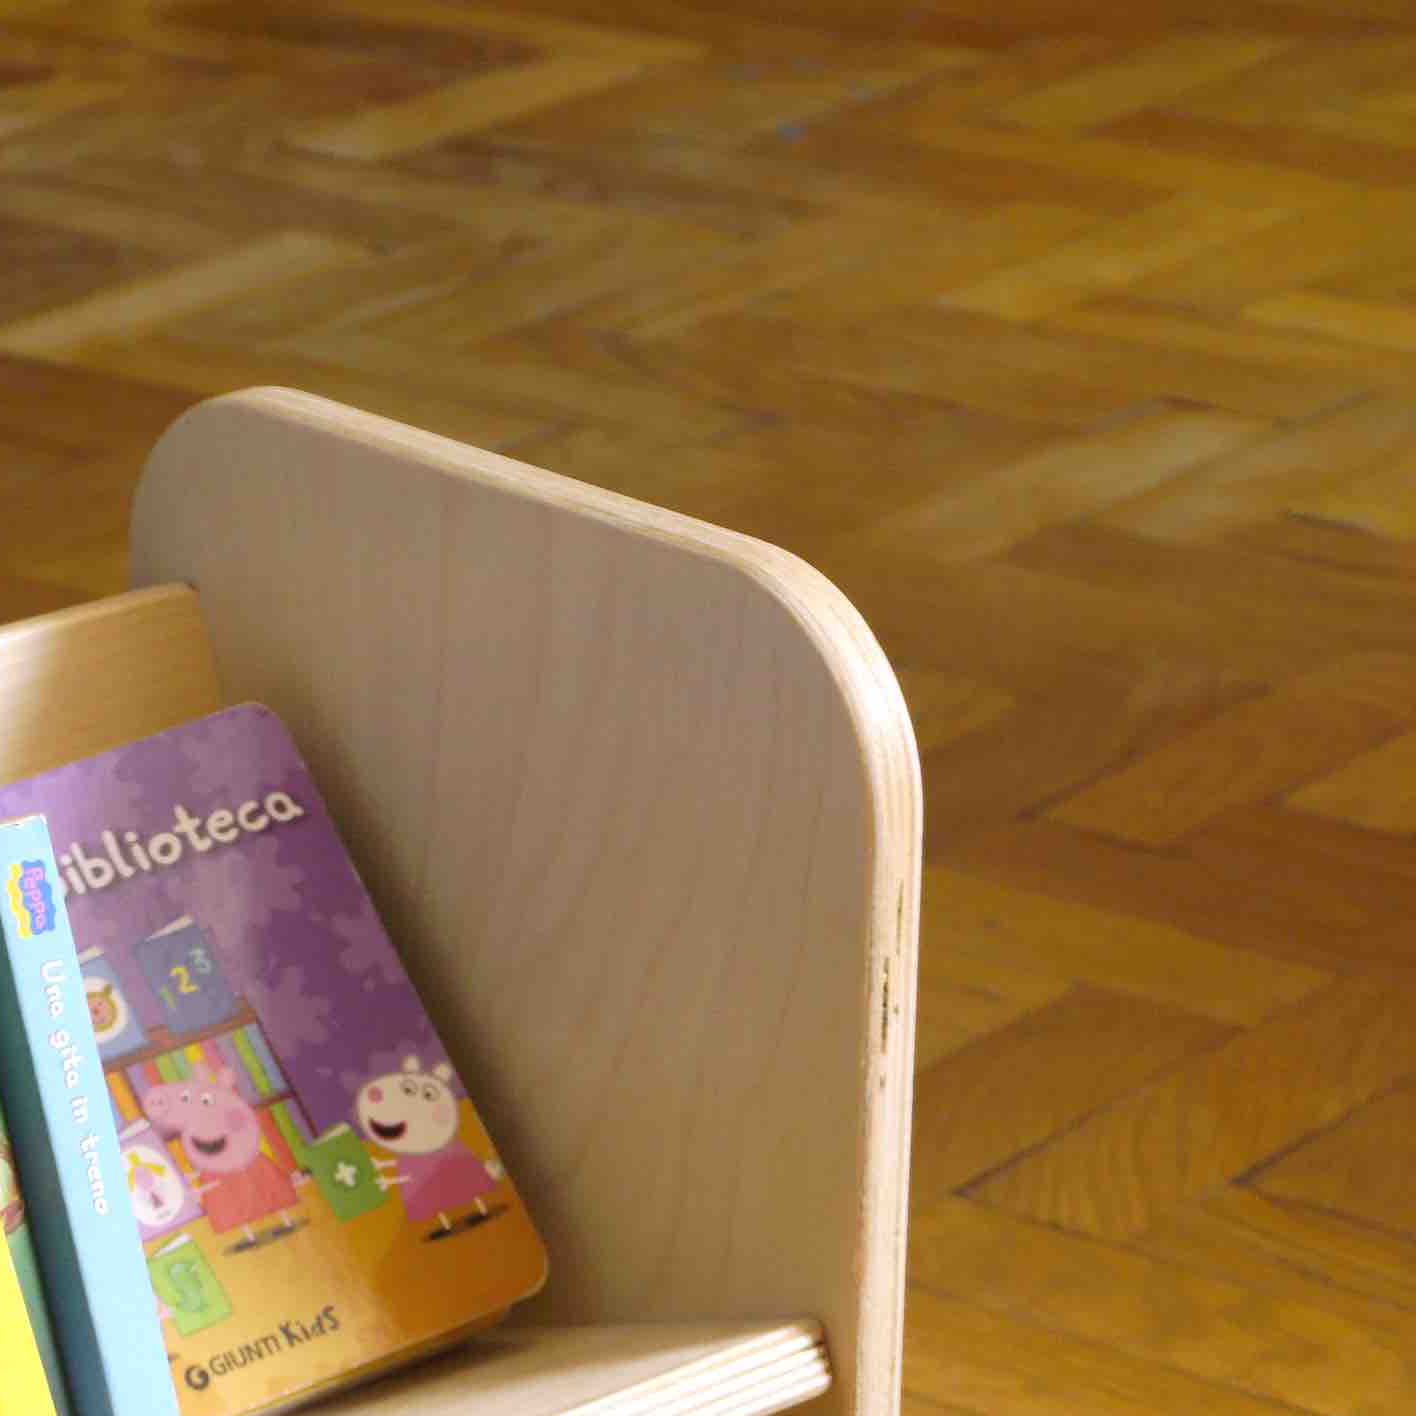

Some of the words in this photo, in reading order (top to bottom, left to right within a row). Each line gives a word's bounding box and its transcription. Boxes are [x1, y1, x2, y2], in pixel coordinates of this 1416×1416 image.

[60, 791, 305, 896] iblioteca
[40, 960, 67, 1016] Una
[49, 1029, 80, 1089] gita
[72, 1096, 89, 1122] in
[80, 1134, 109, 1215] treno
[208, 1333, 281, 1377] GIUNTI
